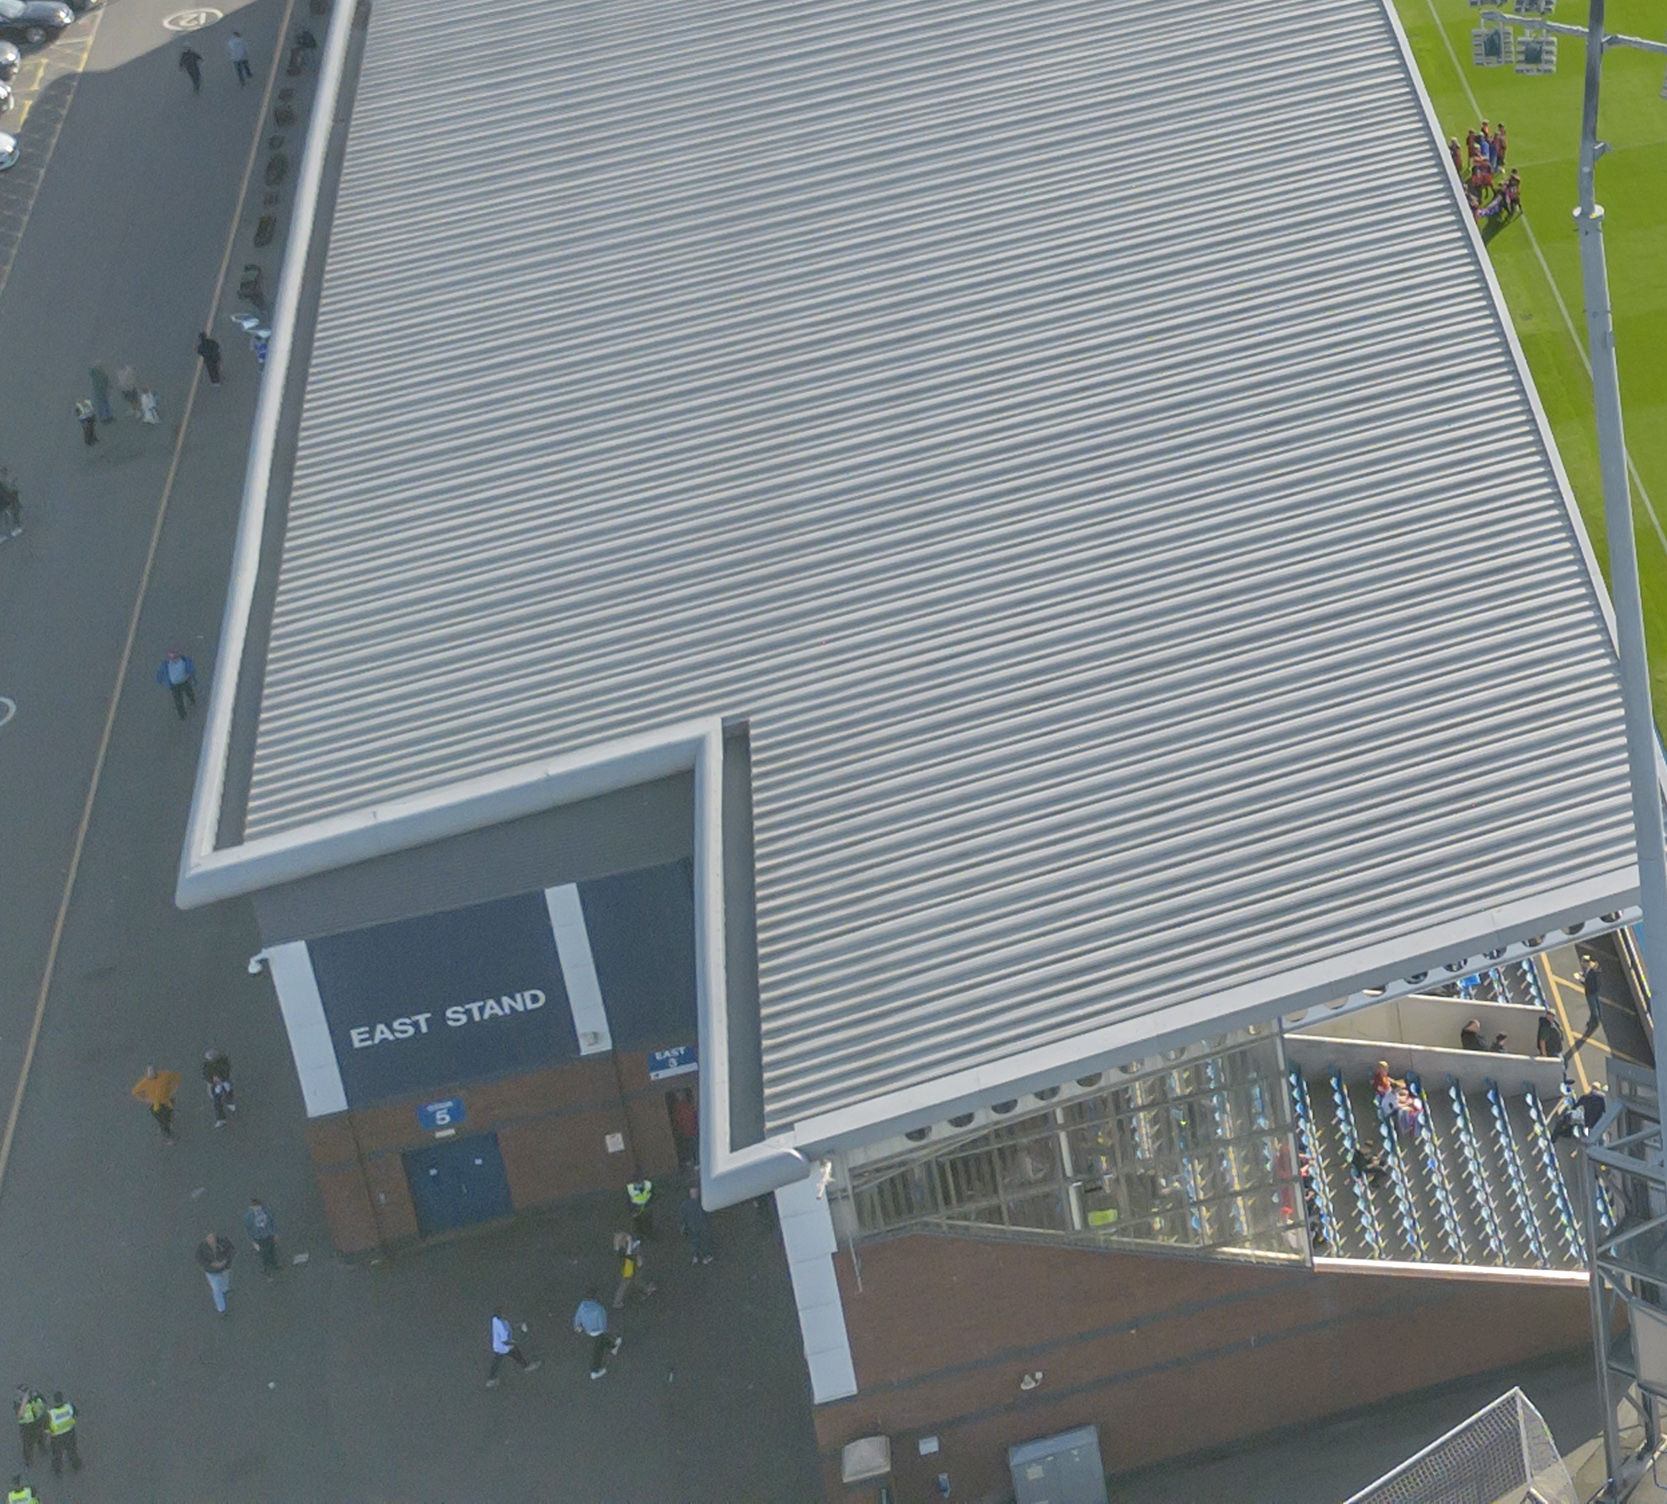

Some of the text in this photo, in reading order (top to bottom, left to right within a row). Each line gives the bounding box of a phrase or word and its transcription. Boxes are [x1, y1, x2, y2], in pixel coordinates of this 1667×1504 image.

[350, 989, 546, 1048] EAST STAND
[654, 1046, 687, 1061] EAST
[435, 1109, 451, 1126] 5
